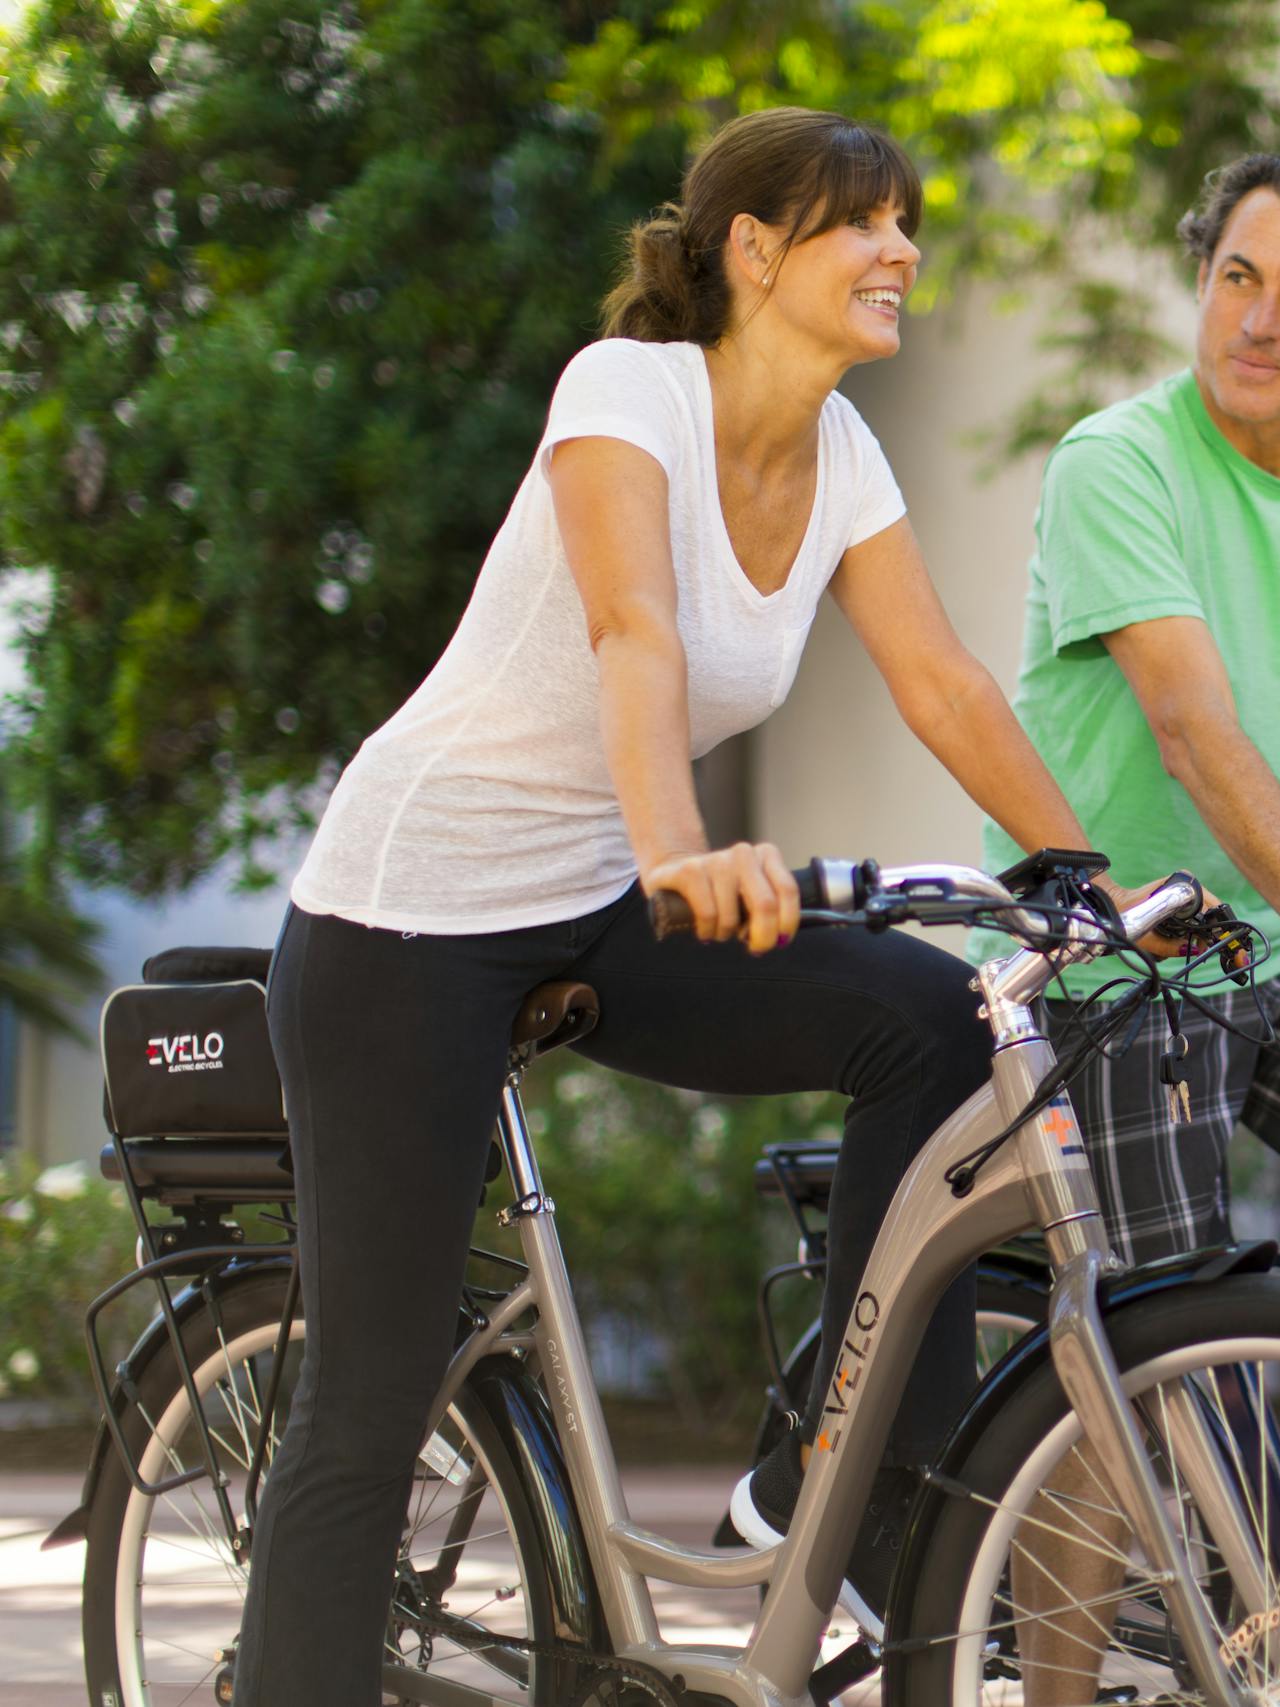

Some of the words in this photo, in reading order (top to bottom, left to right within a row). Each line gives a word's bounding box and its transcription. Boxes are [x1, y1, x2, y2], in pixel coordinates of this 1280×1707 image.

[146, 1032, 224, 1066] EVELO
[546, 1338, 571, 1409] GALAXY
[565, 1412, 578, 1433] ST
[817, 1291, 880, 1453] EVELO
